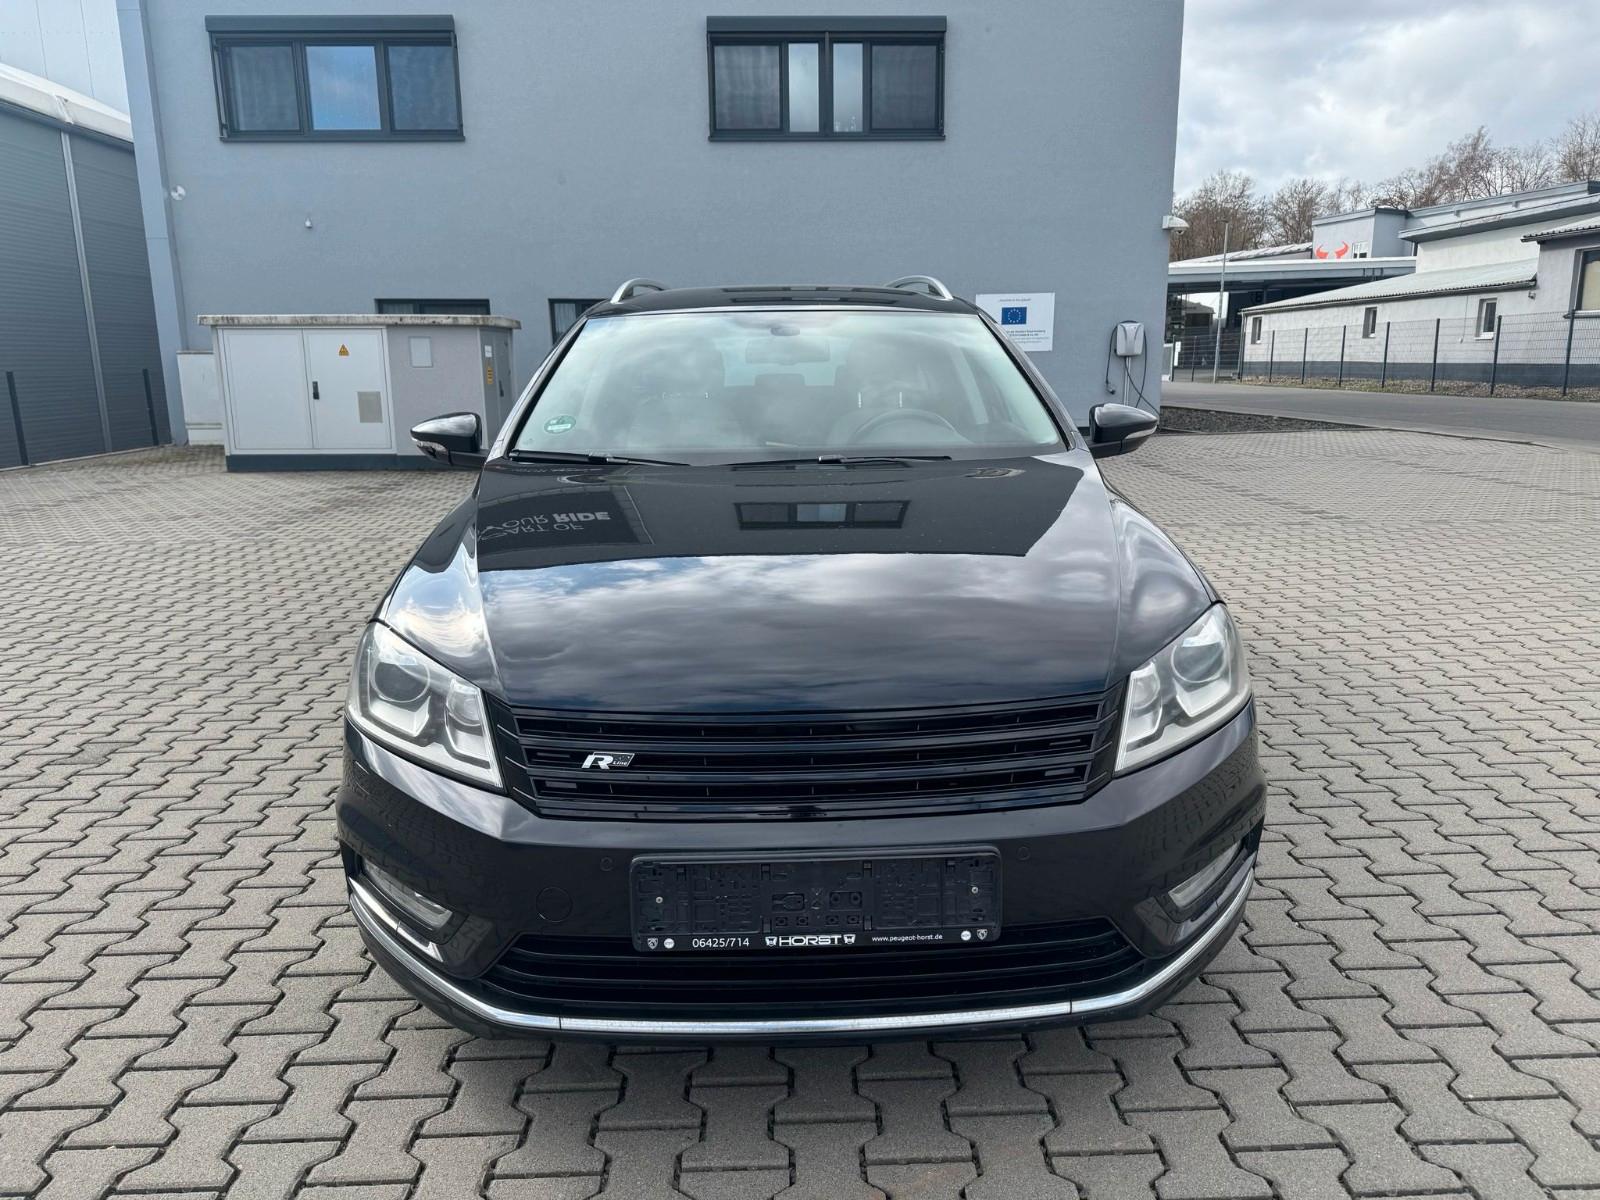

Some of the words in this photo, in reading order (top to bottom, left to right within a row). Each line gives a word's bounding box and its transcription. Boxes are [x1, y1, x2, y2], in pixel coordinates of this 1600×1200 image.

[581, 754, 614, 769] R
[692, 937, 750, 948] 06425/714
[779, 934, 842, 946] HORST
[871, 933, 943, 943] www.peugeot-horst.de
